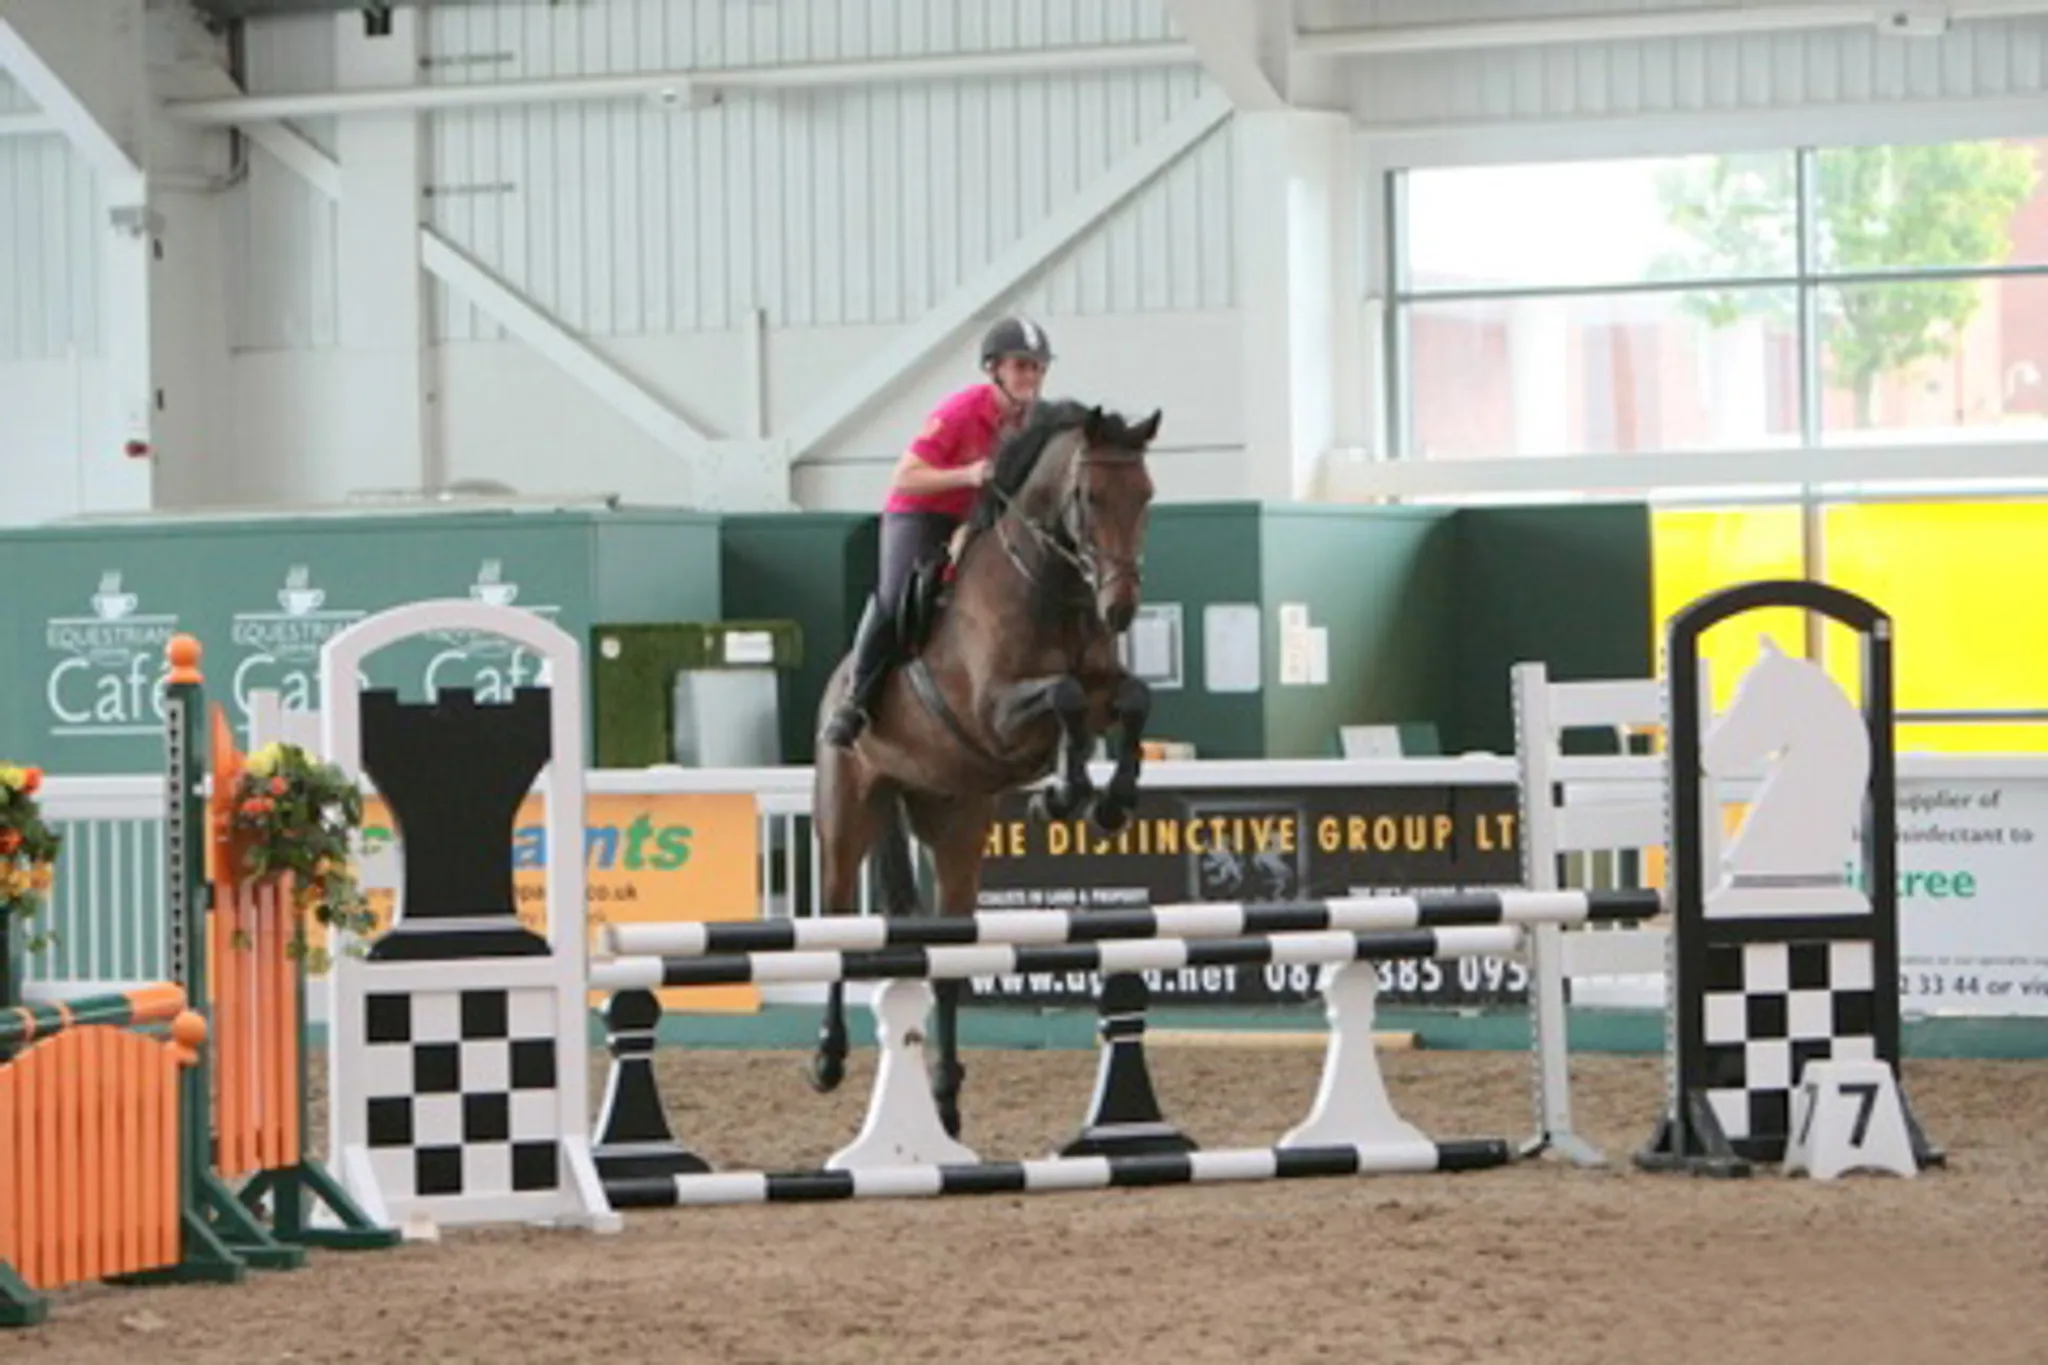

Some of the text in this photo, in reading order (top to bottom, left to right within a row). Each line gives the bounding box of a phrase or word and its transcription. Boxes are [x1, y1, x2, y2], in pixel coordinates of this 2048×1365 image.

[1979, 788, 2002, 808] of
[1317, 814, 1453, 851] GROUP
[1476, 813, 1516, 849] LT
[1919, 973, 1944, 996] 33
[1953, 974, 1981, 996] 44
[1838, 1083, 1879, 1149] 7
